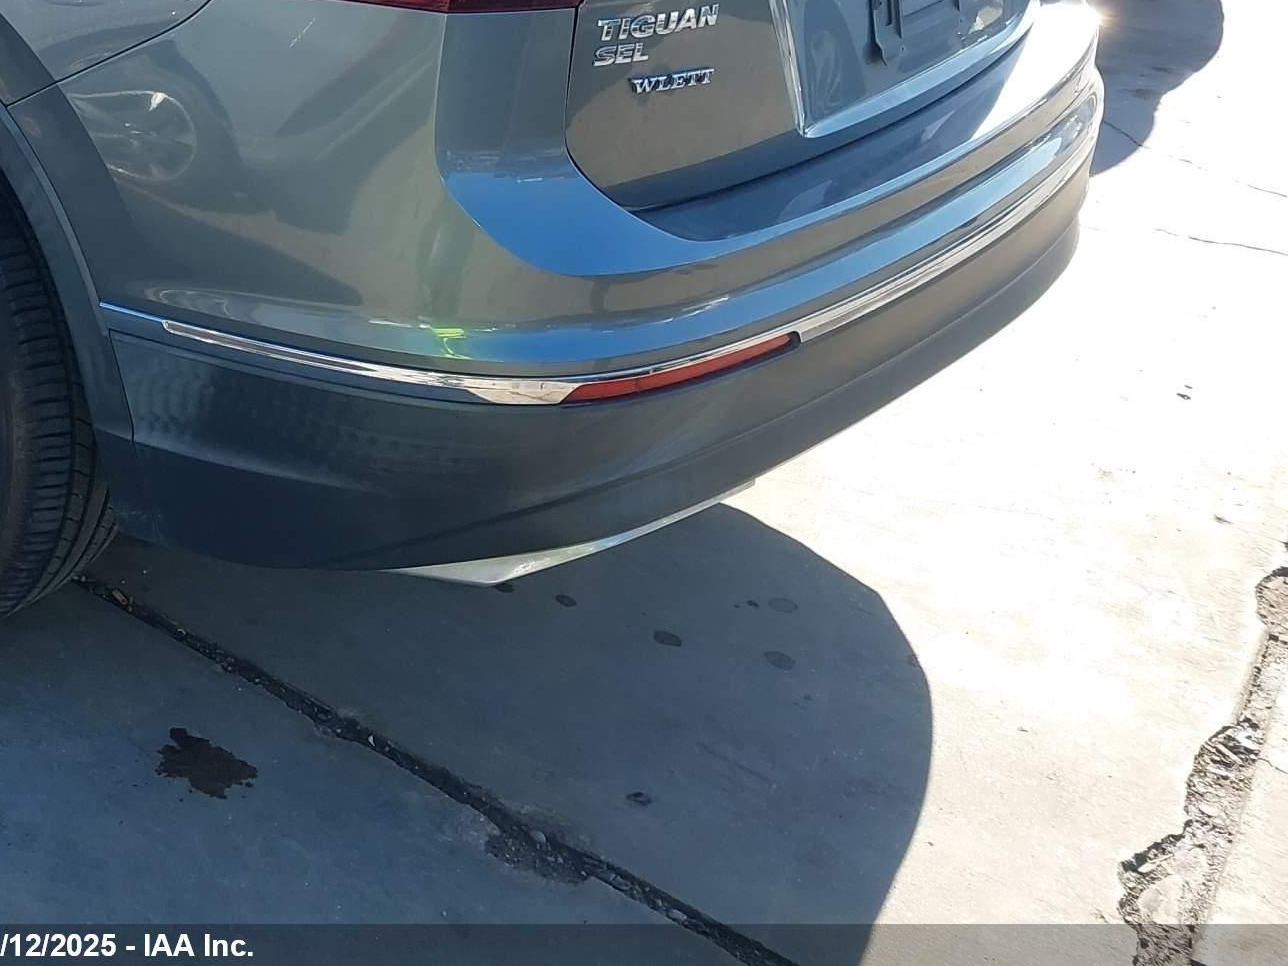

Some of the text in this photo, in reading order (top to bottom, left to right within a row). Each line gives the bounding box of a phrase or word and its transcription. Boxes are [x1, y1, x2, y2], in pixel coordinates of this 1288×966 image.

[597, 4, 719, 41] TIGUAN
[593, 42, 649, 67] SEL
[631, 68, 715, 94] WLETT
